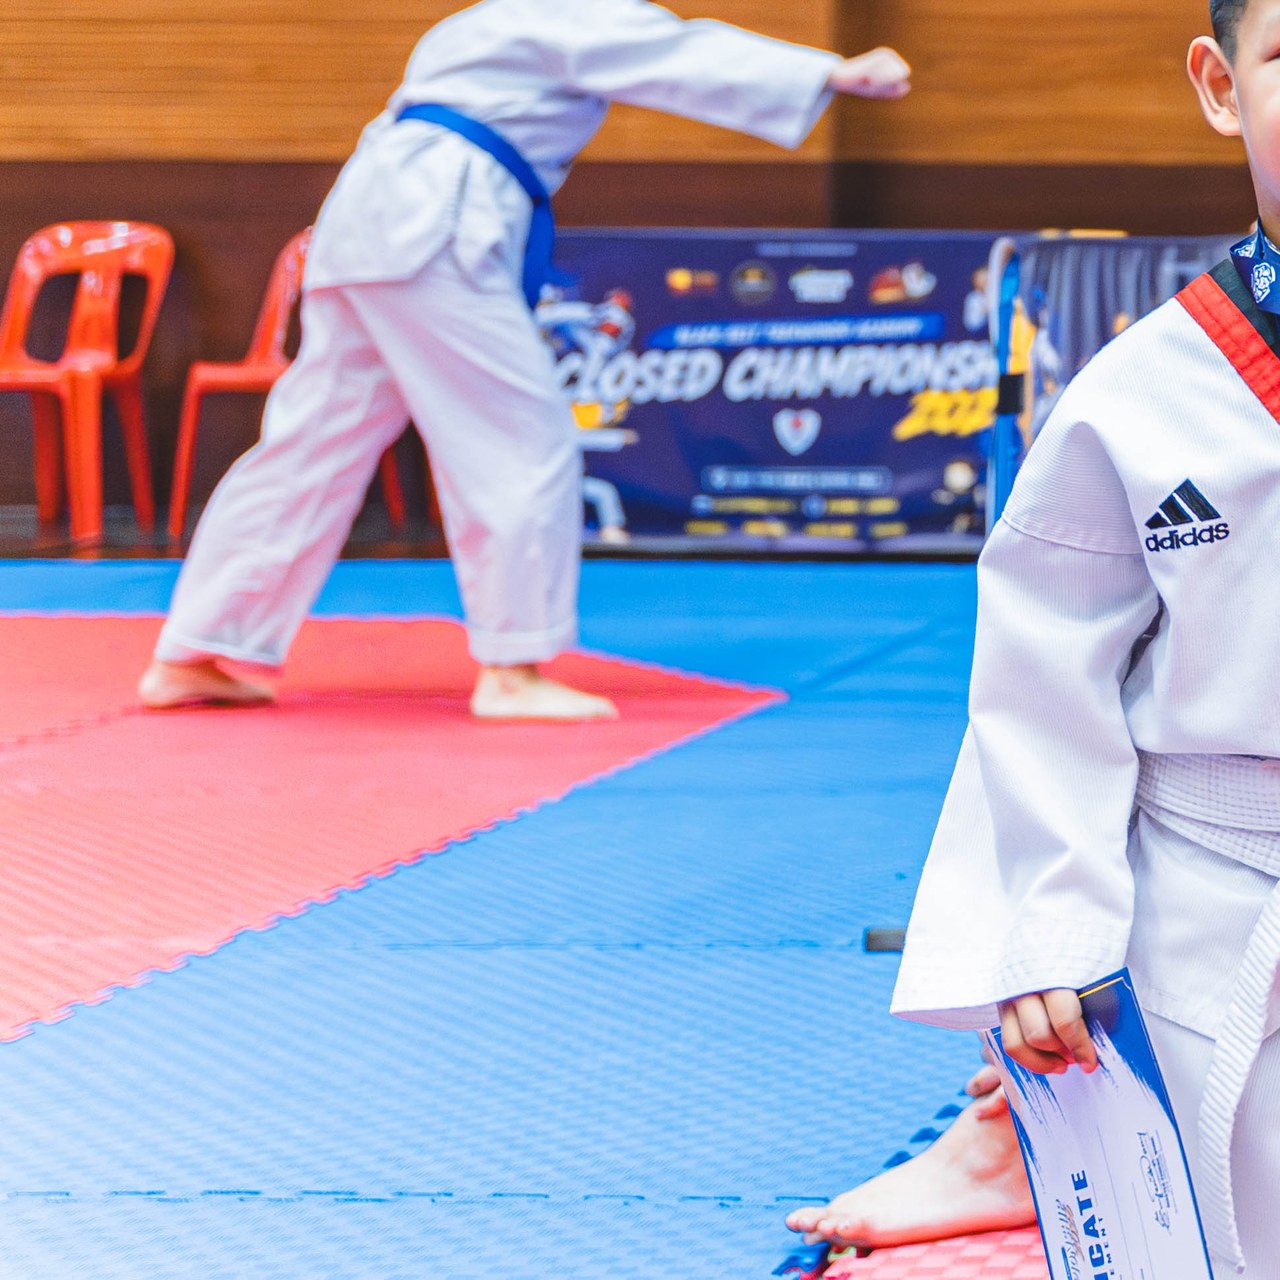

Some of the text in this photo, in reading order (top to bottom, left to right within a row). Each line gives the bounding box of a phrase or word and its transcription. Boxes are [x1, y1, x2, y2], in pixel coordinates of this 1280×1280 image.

[724, 340, 998, 403] CHAMPIONSH
[1145, 523, 1230, 552] adidas
[1071, 1170, 1109, 1280] ICATE
